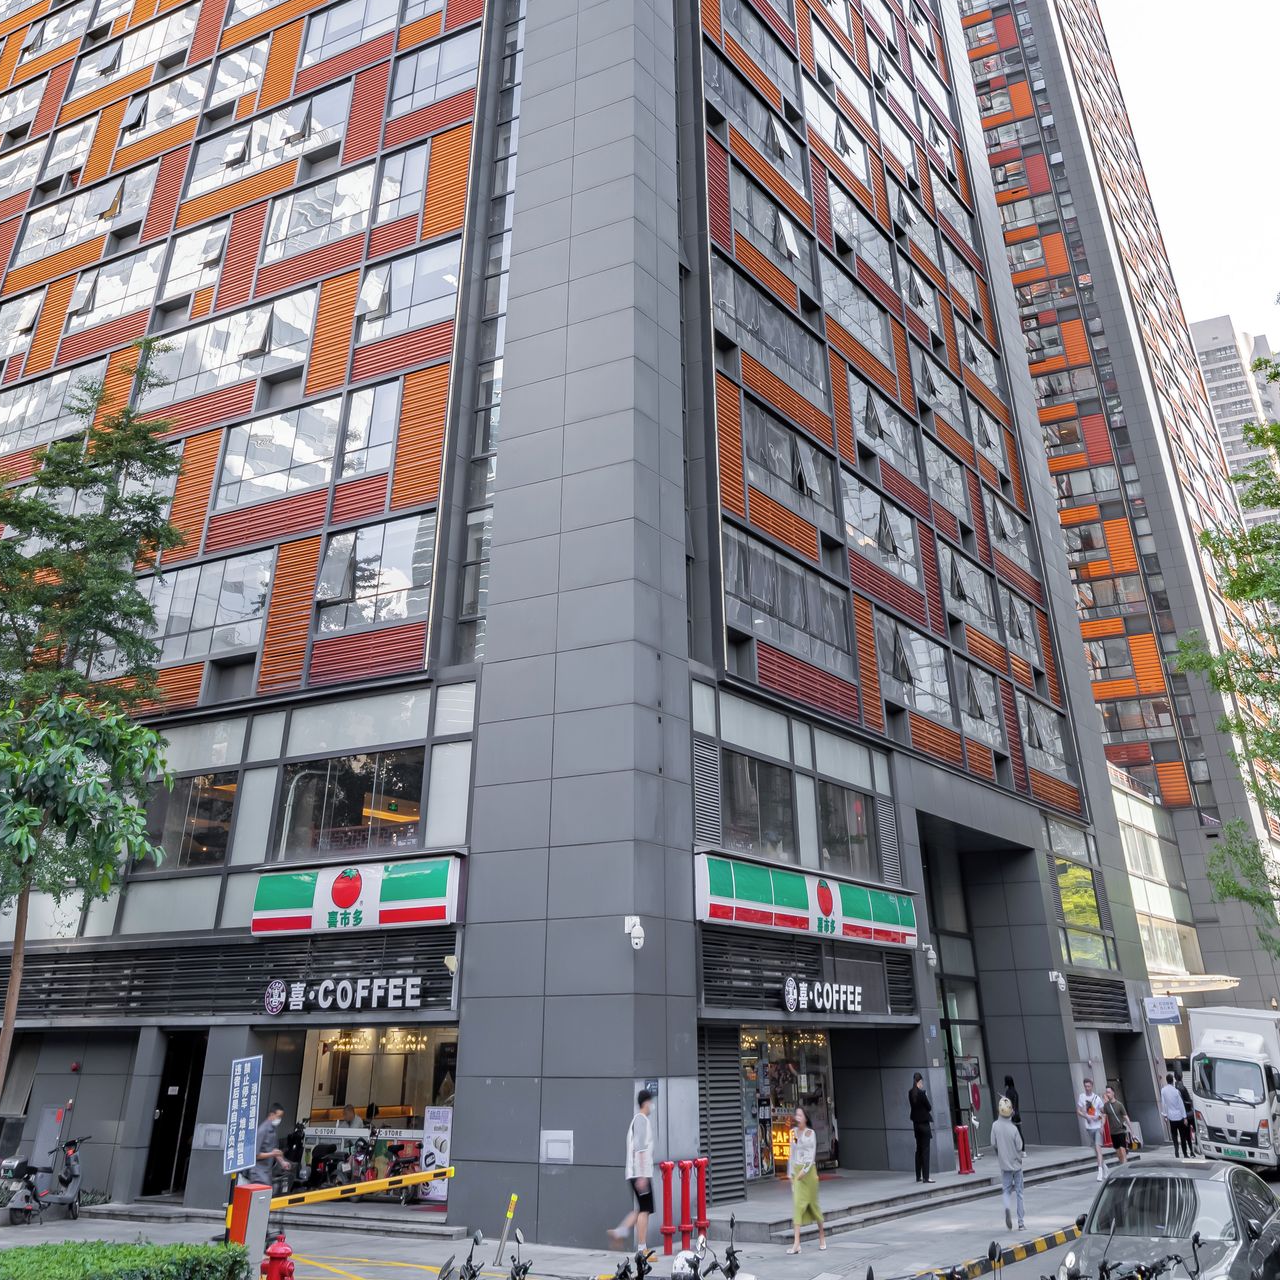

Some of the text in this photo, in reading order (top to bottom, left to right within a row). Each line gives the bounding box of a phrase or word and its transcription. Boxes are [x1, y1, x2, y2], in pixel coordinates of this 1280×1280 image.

[327, 909, 363, 928] 喜市多
[817, 917, 836, 934] 喜市多
[248, 1083, 258, 1129] 消防通道
